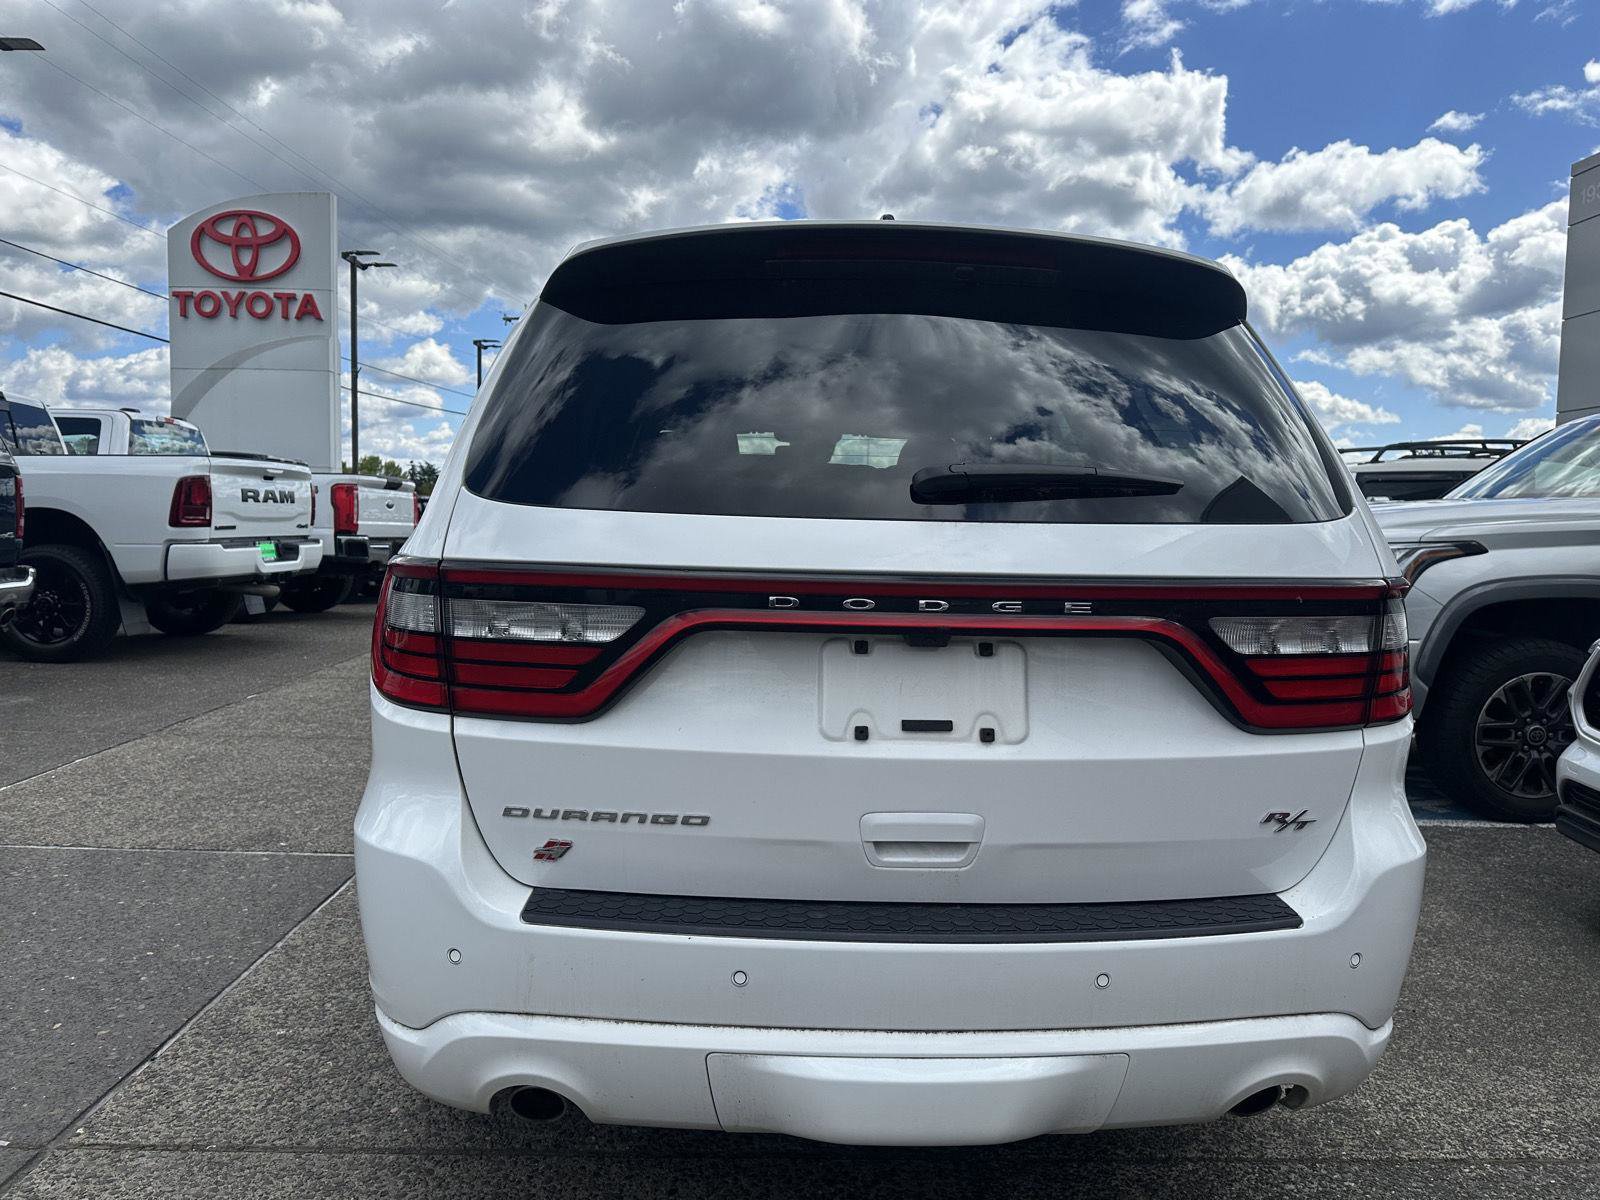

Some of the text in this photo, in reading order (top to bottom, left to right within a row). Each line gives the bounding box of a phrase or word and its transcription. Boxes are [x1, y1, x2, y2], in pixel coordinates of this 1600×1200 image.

[172, 290, 324, 321] TOYOTA
[241, 488, 296, 504] RAM
[768, 595, 1093, 614] DODGE
[502, 806, 711, 826] DURANGO
[1259, 809, 1318, 833] R/T
